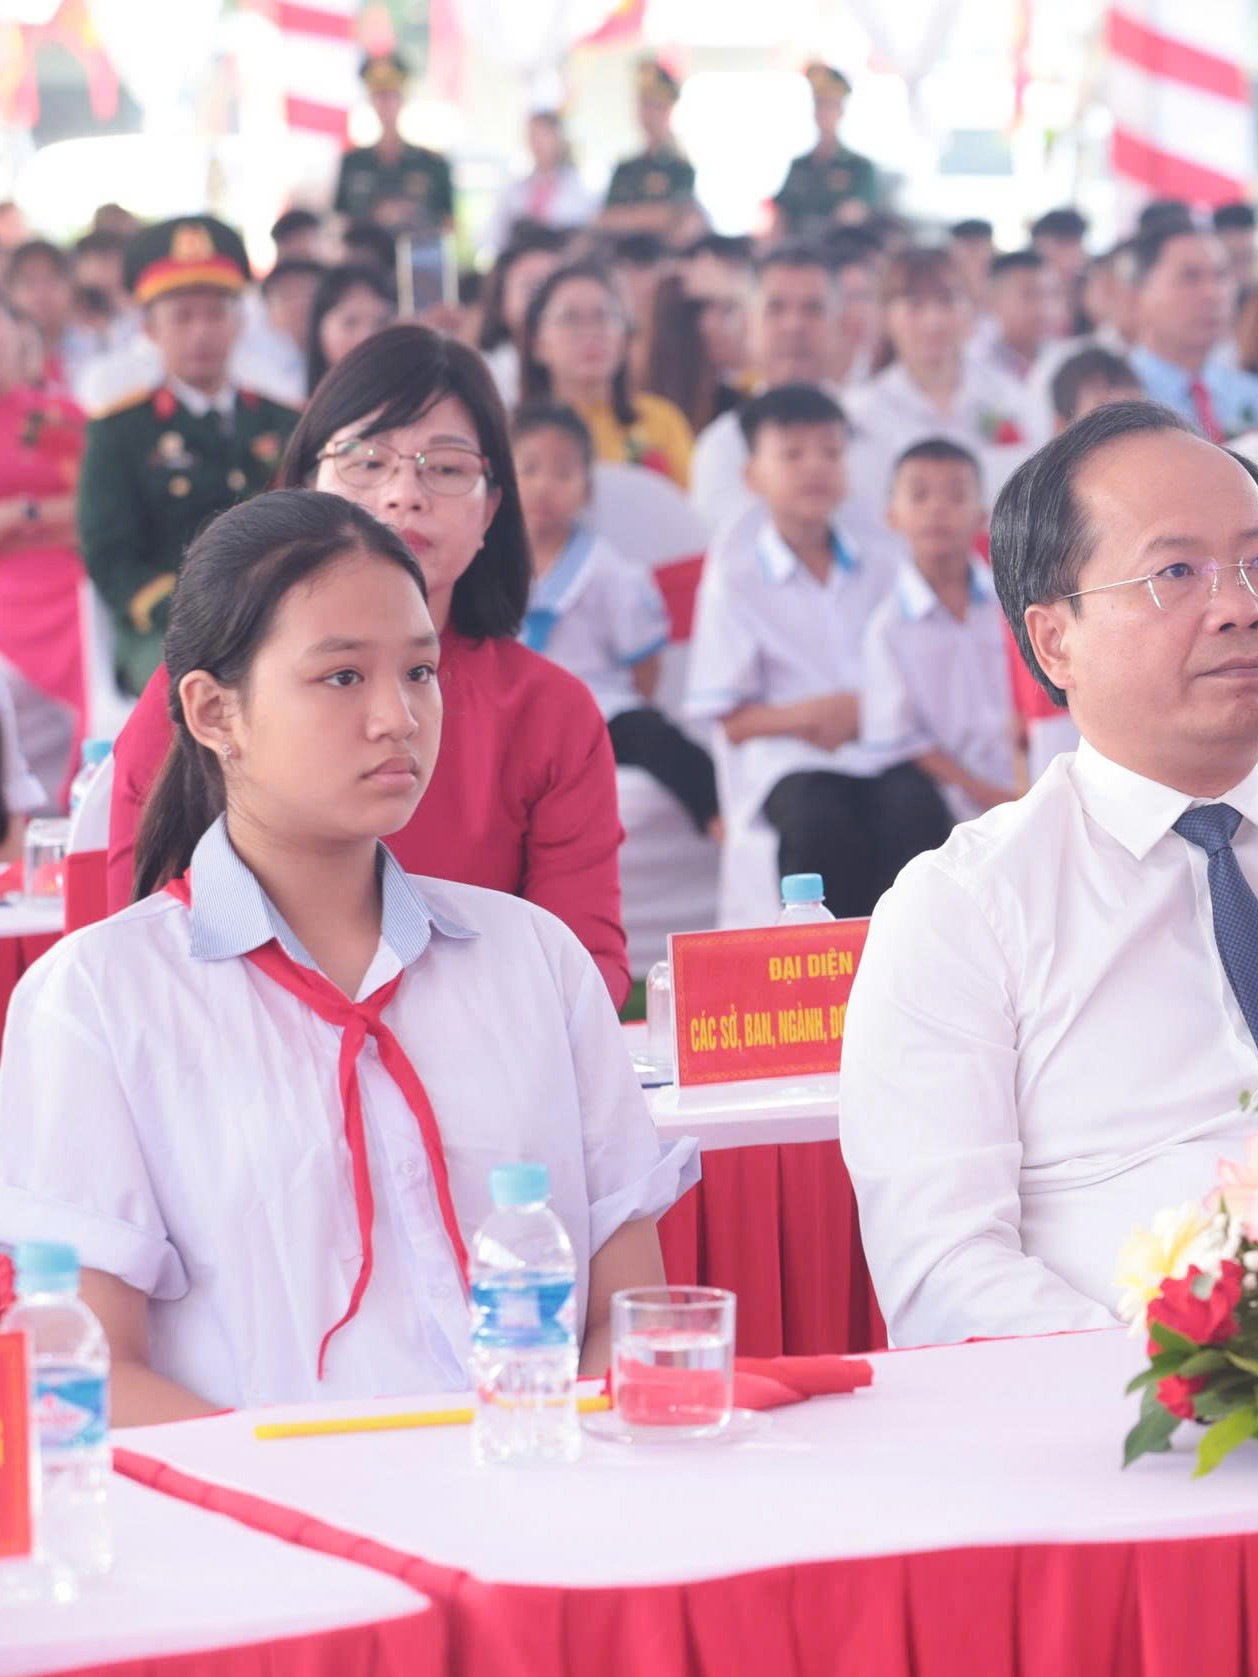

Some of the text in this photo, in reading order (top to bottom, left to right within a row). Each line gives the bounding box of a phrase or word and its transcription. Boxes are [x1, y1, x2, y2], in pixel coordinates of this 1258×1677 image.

[768, 947, 853, 984] ĐẠI DIỆN
[690, 1010, 717, 1053] CÁC
[720, 1003, 742, 1053] SỞ,
[744, 1011, 776, 1049] BAN,
[778, 1001, 828, 1045] NGÀNH,
